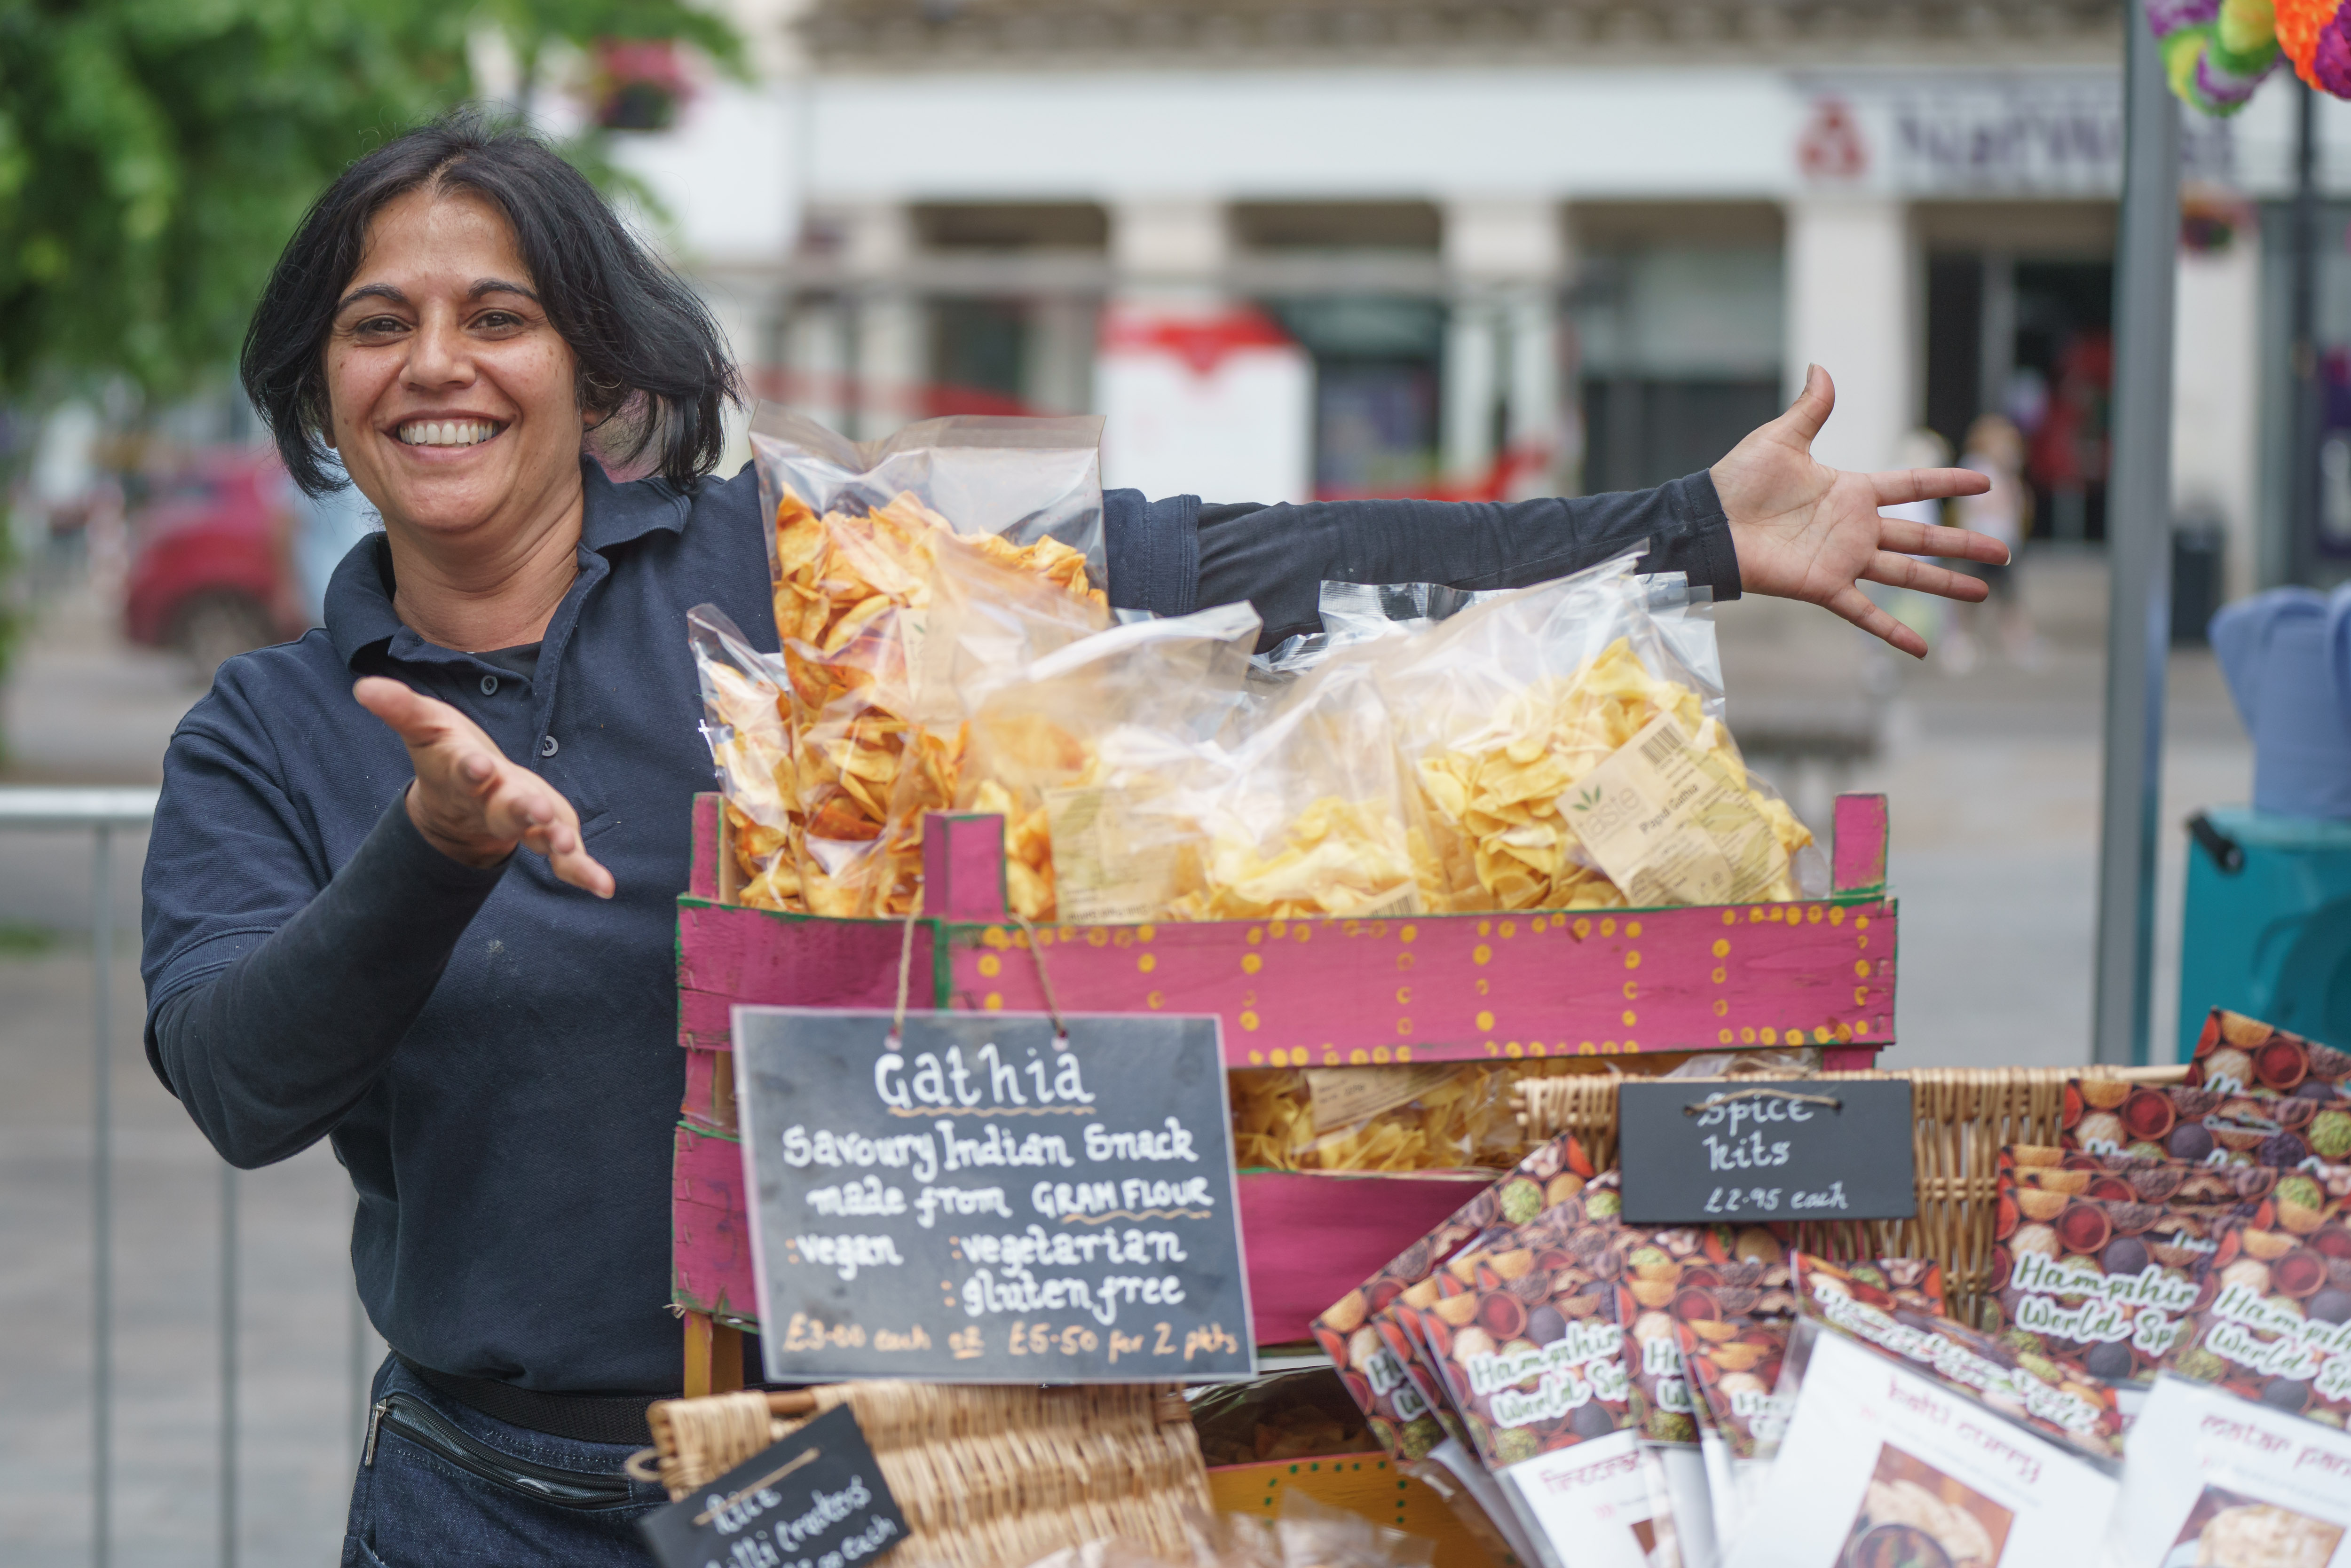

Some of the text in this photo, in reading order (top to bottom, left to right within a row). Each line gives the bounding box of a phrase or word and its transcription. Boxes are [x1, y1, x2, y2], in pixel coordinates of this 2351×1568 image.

[874, 1042, 1096, 1109] Gathia
[1696, 1092, 1815, 1137] Spice
[782, 1116, 1199, 1183] Savoury Indian Snack
[1702, 1130, 1791, 1171] kits
[805, 1174, 1215, 1229] made from GRAM FLOUR
[1790, 1181, 1849, 1210] each
[1091, 1275, 1187, 1326] free
[2012, 1251, 2201, 1311] Hampshir
[873, 1323, 932, 1352] each
[1108, 1328, 1145, 1364] for
[1152, 1321, 1178, 1356] 2
[2016, 1295, 2133, 1343] World
[2206, 1320, 2319, 1380] World
[1491, 1369, 1593, 1428] World
